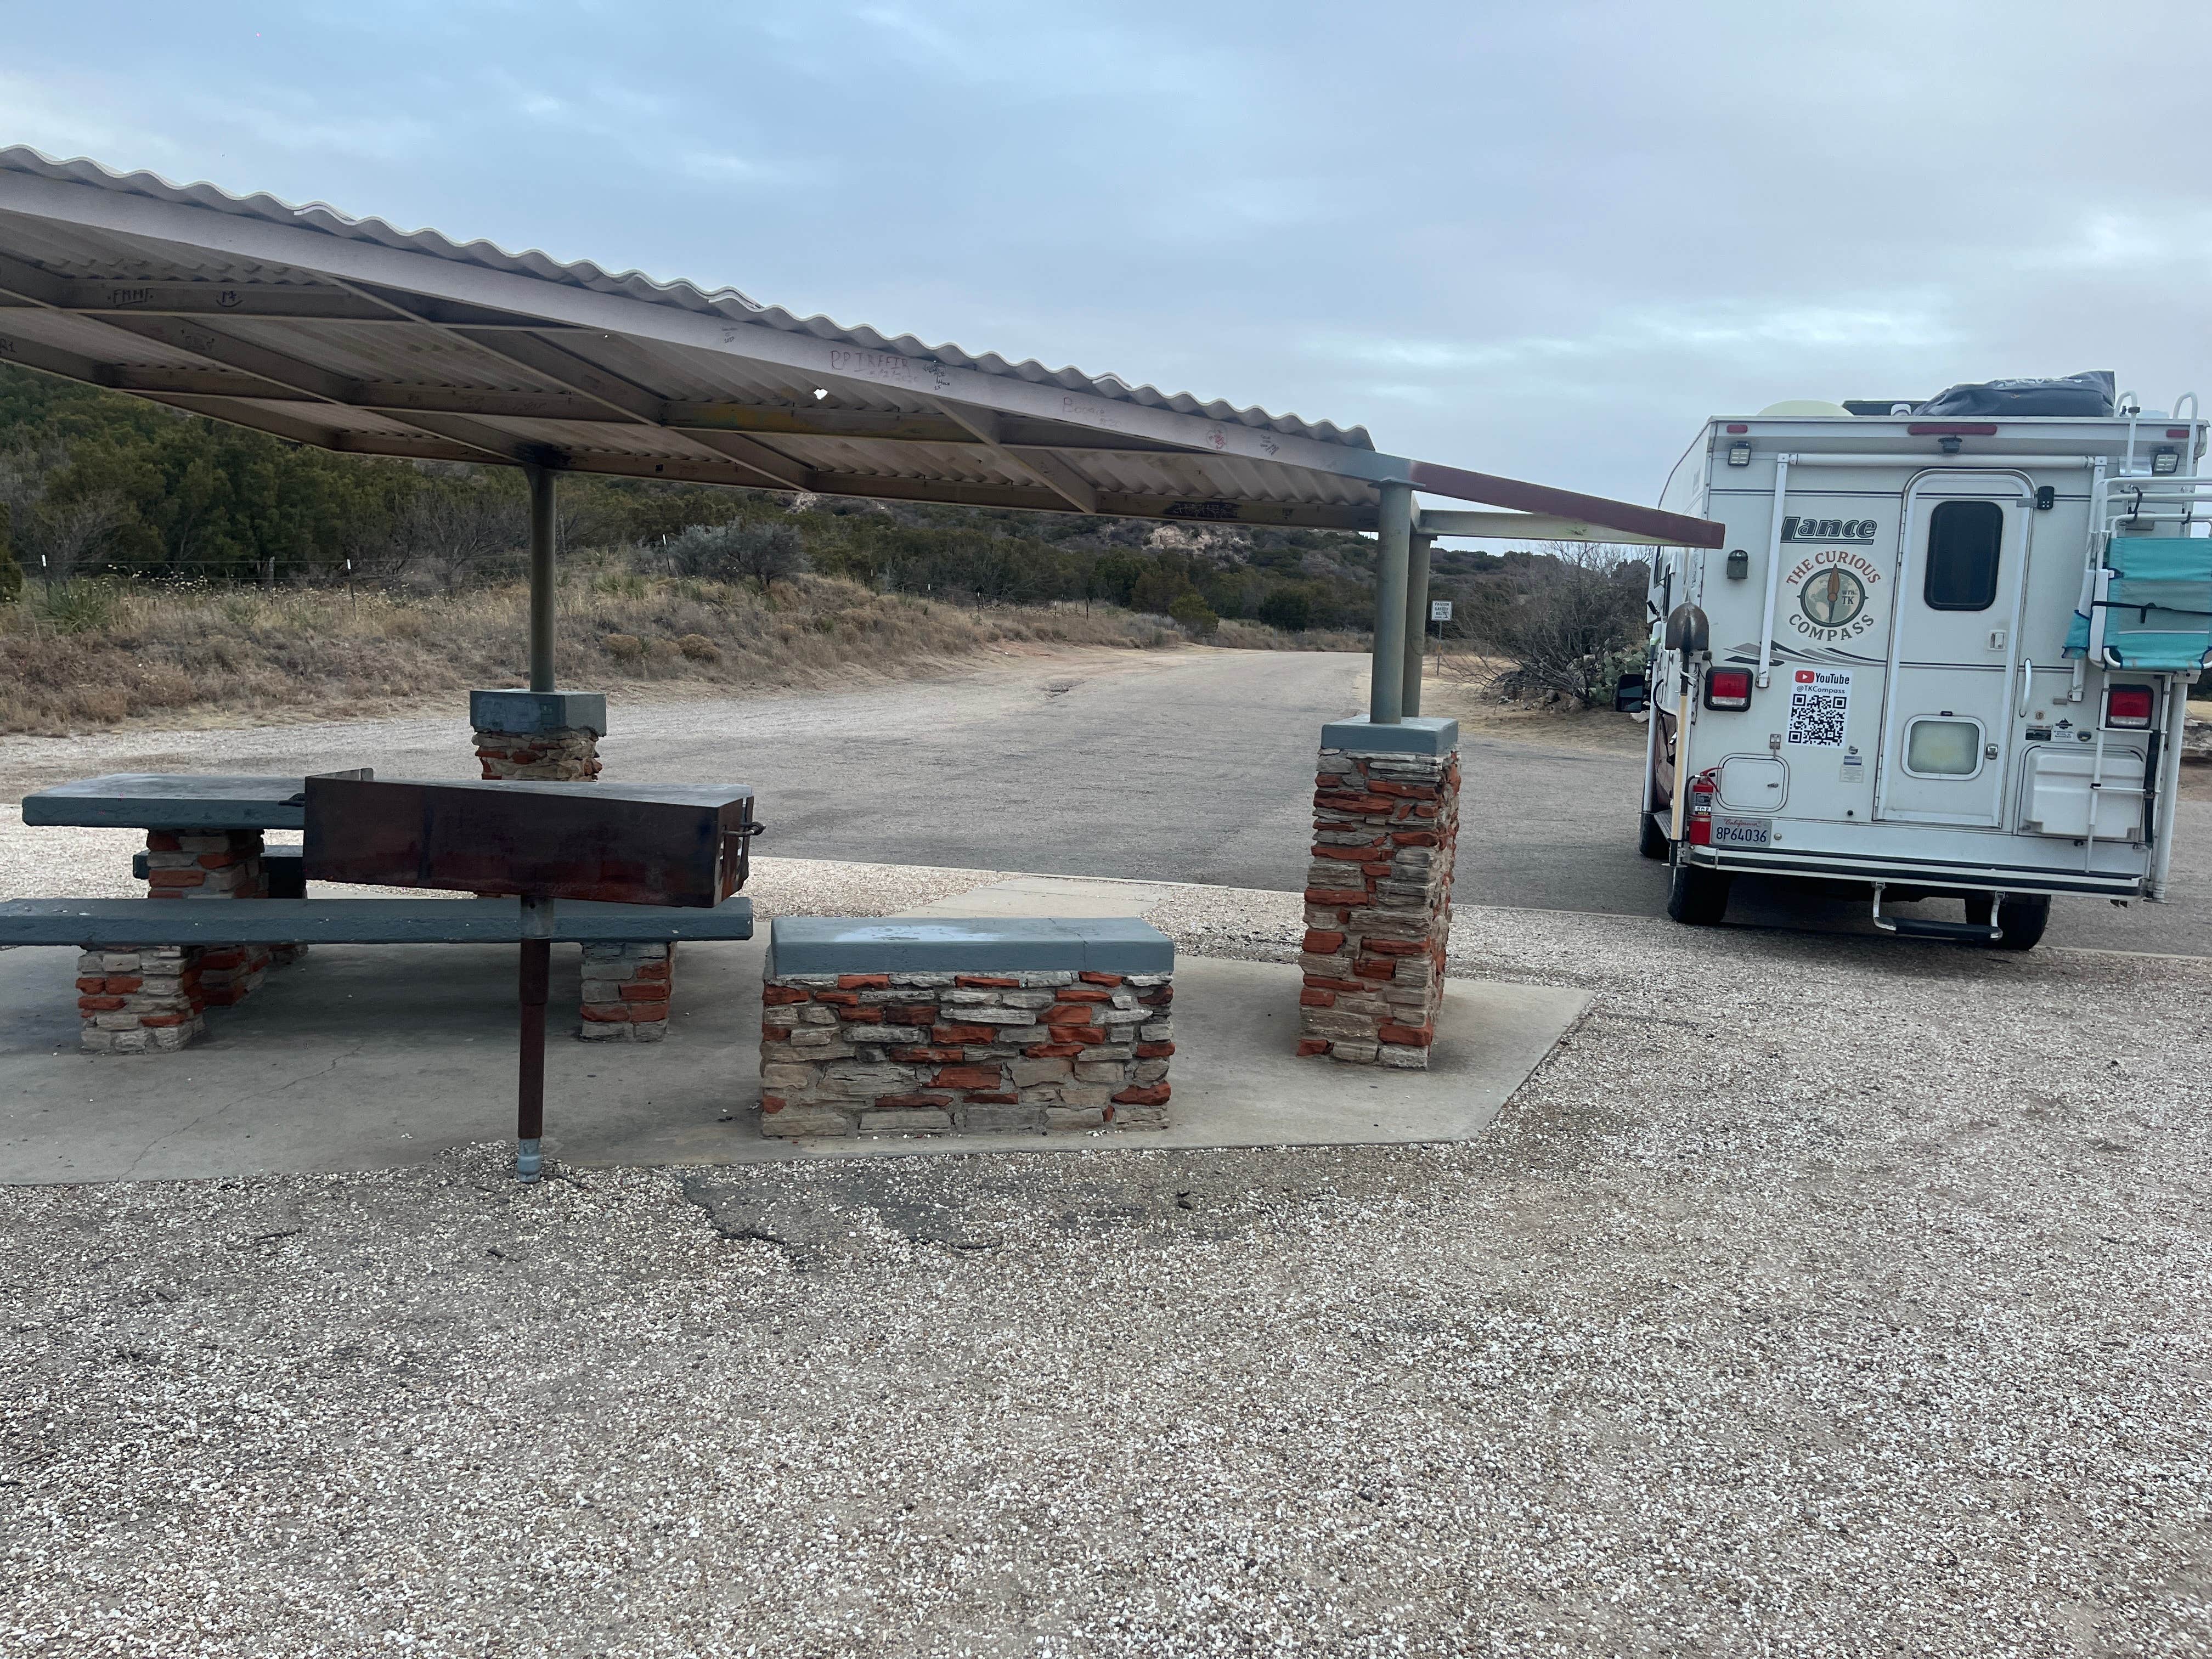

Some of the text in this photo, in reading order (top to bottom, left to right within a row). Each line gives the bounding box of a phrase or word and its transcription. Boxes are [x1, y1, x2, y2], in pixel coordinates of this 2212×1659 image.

[1780, 516, 1877, 545] Lance
[1786, 551, 1881, 585] THE CURIOUS
[1842, 596, 1854, 605] TK
[1789, 614, 1875, 641] COMPASS
[1816, 673, 1850, 685] YouTube
[1796, 685, 1846, 695] @TKCompass
[1716, 827, 1767, 843] 8P64036
